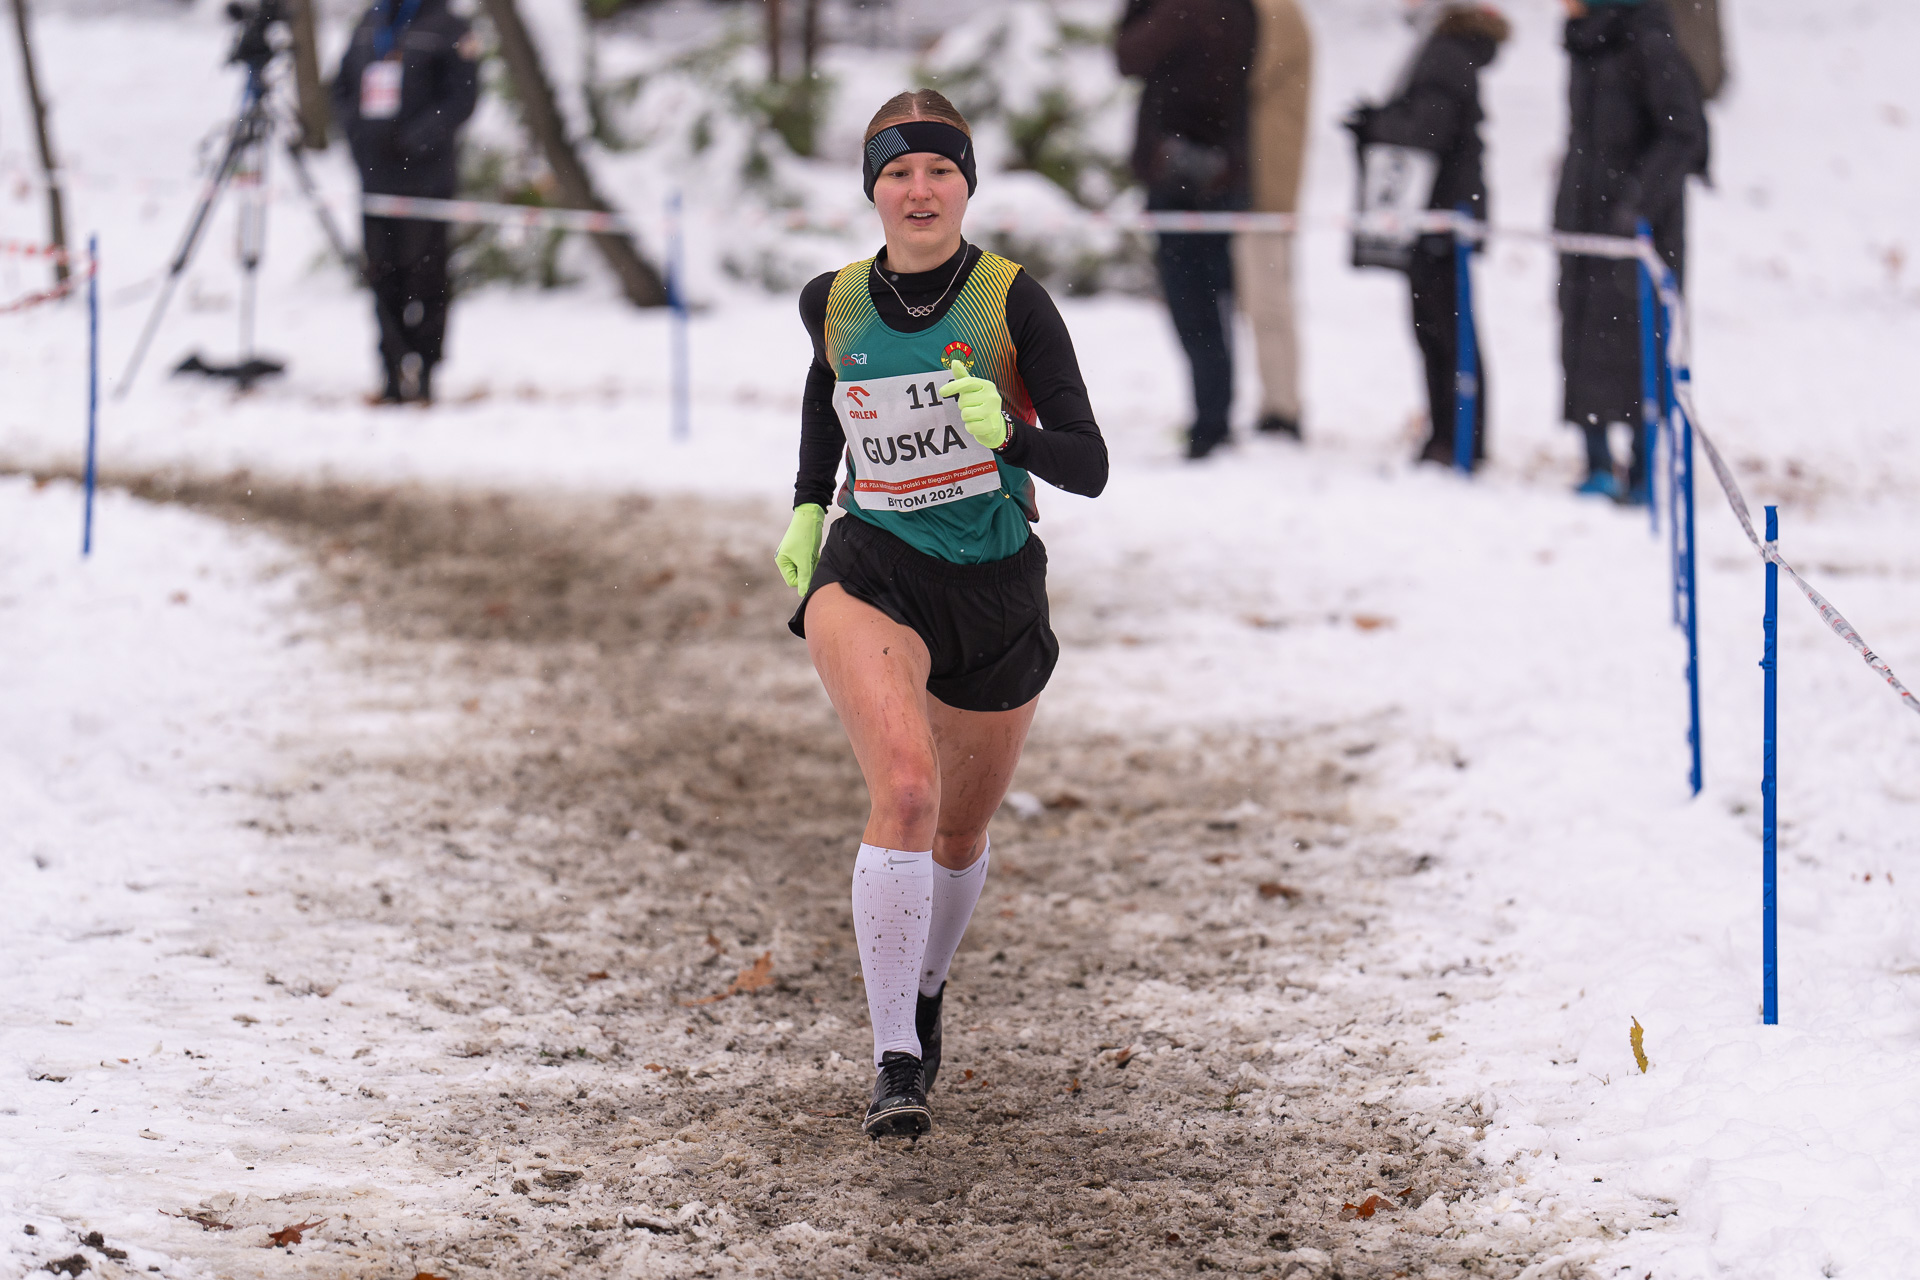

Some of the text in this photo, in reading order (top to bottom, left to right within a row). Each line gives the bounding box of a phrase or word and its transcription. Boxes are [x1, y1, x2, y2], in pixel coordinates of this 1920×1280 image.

[949, 342, 969, 352] LKS
[849, 410, 878, 419] ORLEN
[862, 424, 967, 466] GUSKA
[902, 480, 921, 490] Polski
[927, 474, 953, 484] Biegach
[929, 486, 964, 502] 2024
